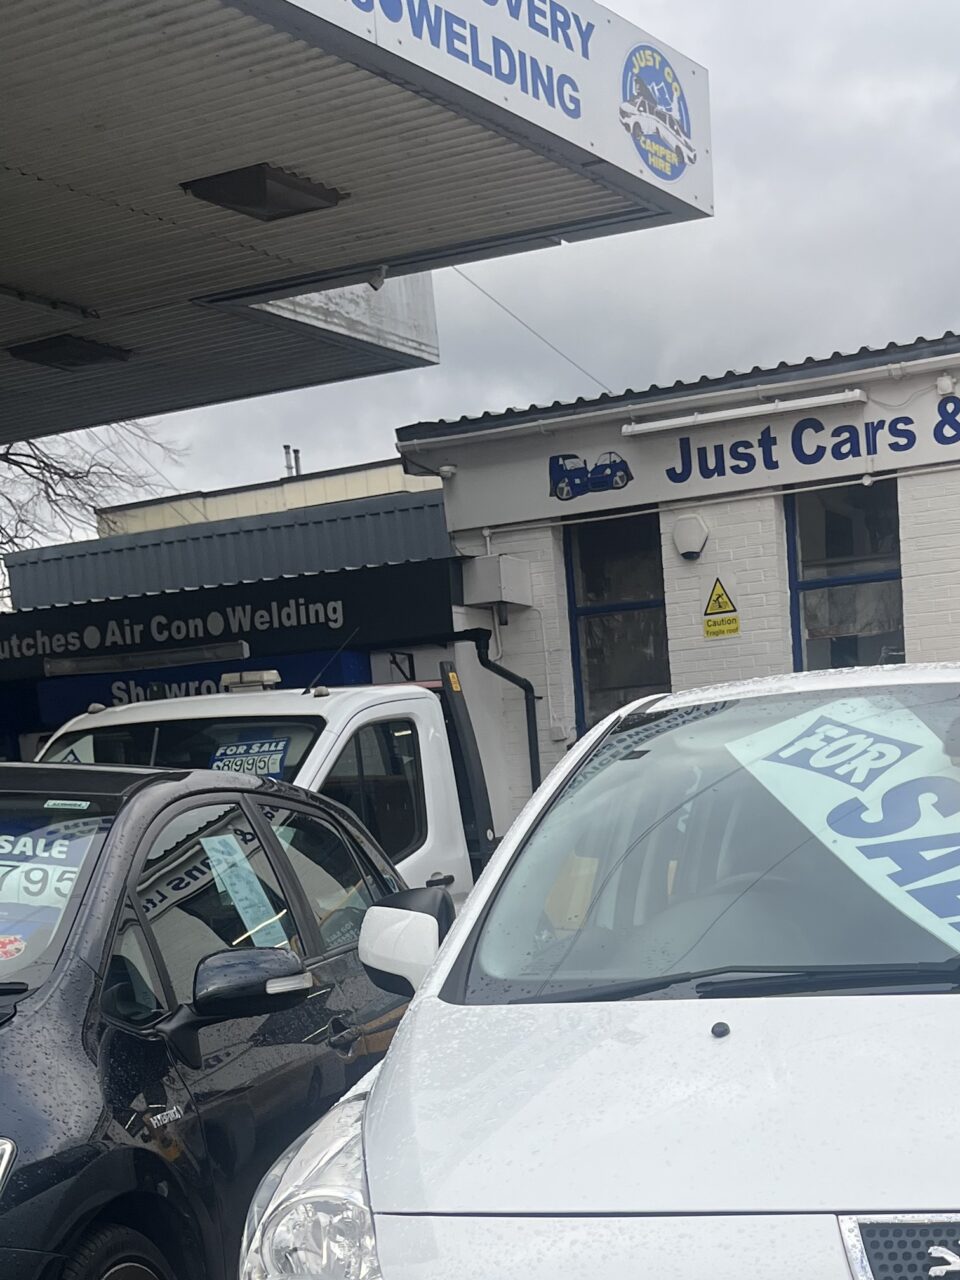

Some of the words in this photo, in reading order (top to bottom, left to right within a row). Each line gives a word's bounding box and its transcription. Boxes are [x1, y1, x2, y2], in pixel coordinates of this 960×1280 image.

[481, 0, 595, 60] VERY
[406, 0, 582, 119] WELDING
[632, 49, 661, 74] JUST
[639, 135, 679, 167] CAMPER
[648, 153, 672, 176] HIRE
[665, 425, 779, 483] Just
[791, 416, 917, 465] Cars
[0, 630, 81, 660] utches
[105, 619, 144, 646] Air
[151, 615, 204, 642] Con
[226, 598, 344, 634] Welding
[706, 617, 737, 628] Caution
[111, 679, 232, 706] Shwro
[215, 745, 247, 757] FOR
[249, 741, 286, 754] SALE
[778, 723, 902, 785] FOR
[0, 833, 69, 859] SALE
[149, 1105, 184, 1129] HYBRID
